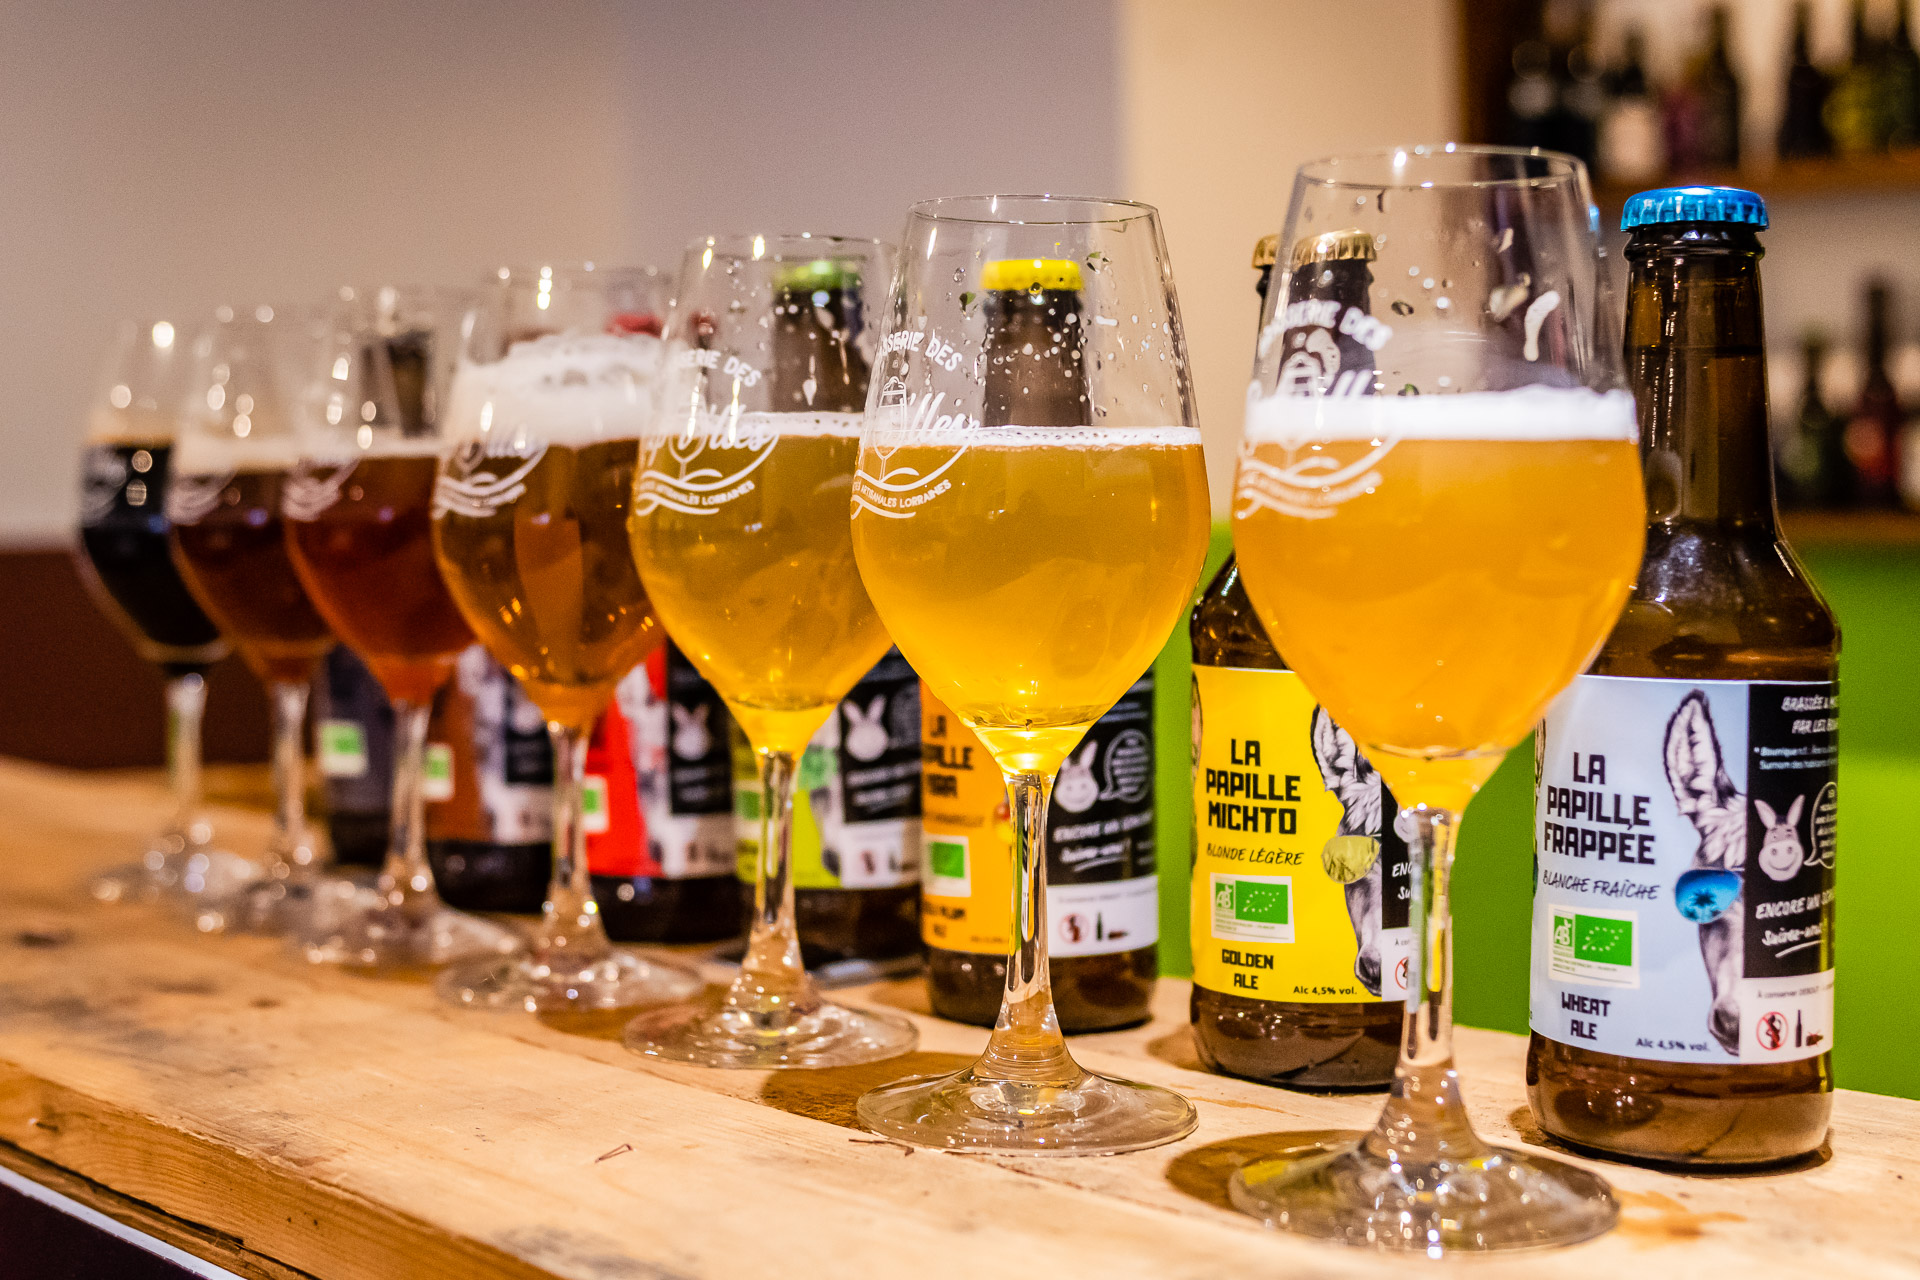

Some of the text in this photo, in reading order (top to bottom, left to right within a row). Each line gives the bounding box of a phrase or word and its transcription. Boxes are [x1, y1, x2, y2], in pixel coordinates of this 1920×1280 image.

[925, 338, 962, 371] DES
[900, 479, 952, 508] LORRAINES
[1231, 739, 1261, 767] LA
[1573, 752, 1606, 785] LA
[1206, 768, 1302, 802] PAPILLE
[1208, 801, 1297, 835] MICHTO
[1547, 785, 1651, 826] PAPILLE
[1206, 843, 1304, 866] BLONDE LÉGÈRE
[1544, 821, 1656, 865] FRAPPÉE
[1543, 869, 1590, 893] BLANCHE
[1756, 897, 1806, 919] ENCORE
[1222, 948, 1274, 970] GOLDEN
[1234, 973, 1259, 990] ALE
[1293, 986, 1357, 995] Alc 4,5% vol.
[1561, 991, 1611, 1017] WHEAT
[1570, 1019, 1598, 1040] ALE
[1635, 1038, 1653, 1048] Alc
[1658, 1040, 1686, 1050] 4,5%
